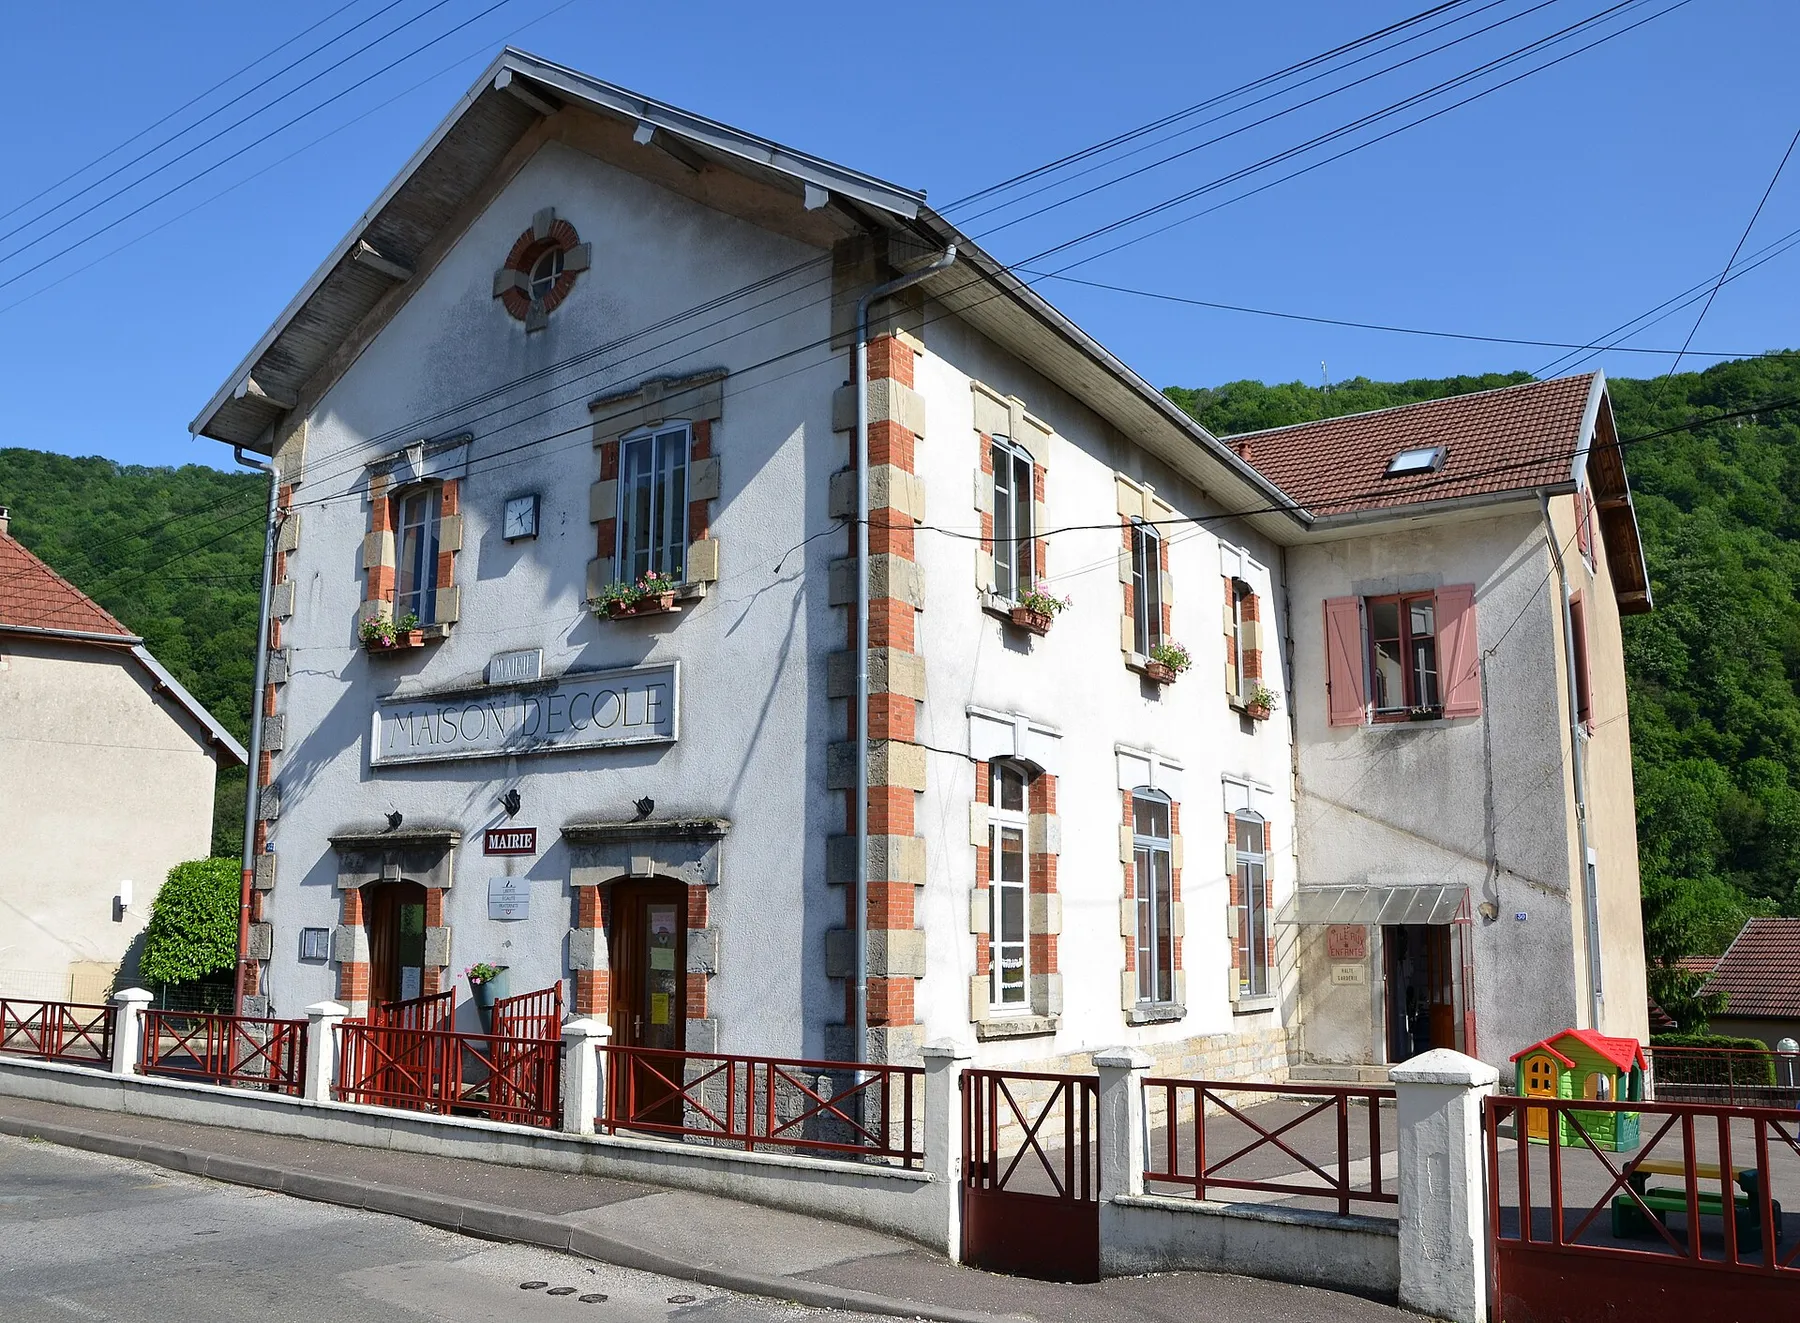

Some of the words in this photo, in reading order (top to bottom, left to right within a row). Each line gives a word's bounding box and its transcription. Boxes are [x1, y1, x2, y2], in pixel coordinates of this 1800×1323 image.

[494, 655, 535, 679] MAIRIE
[390, 701, 507, 748] MAISON
[488, 833, 533, 849] MAIRIE
[1330, 948, 1363, 957] ENFANTS
